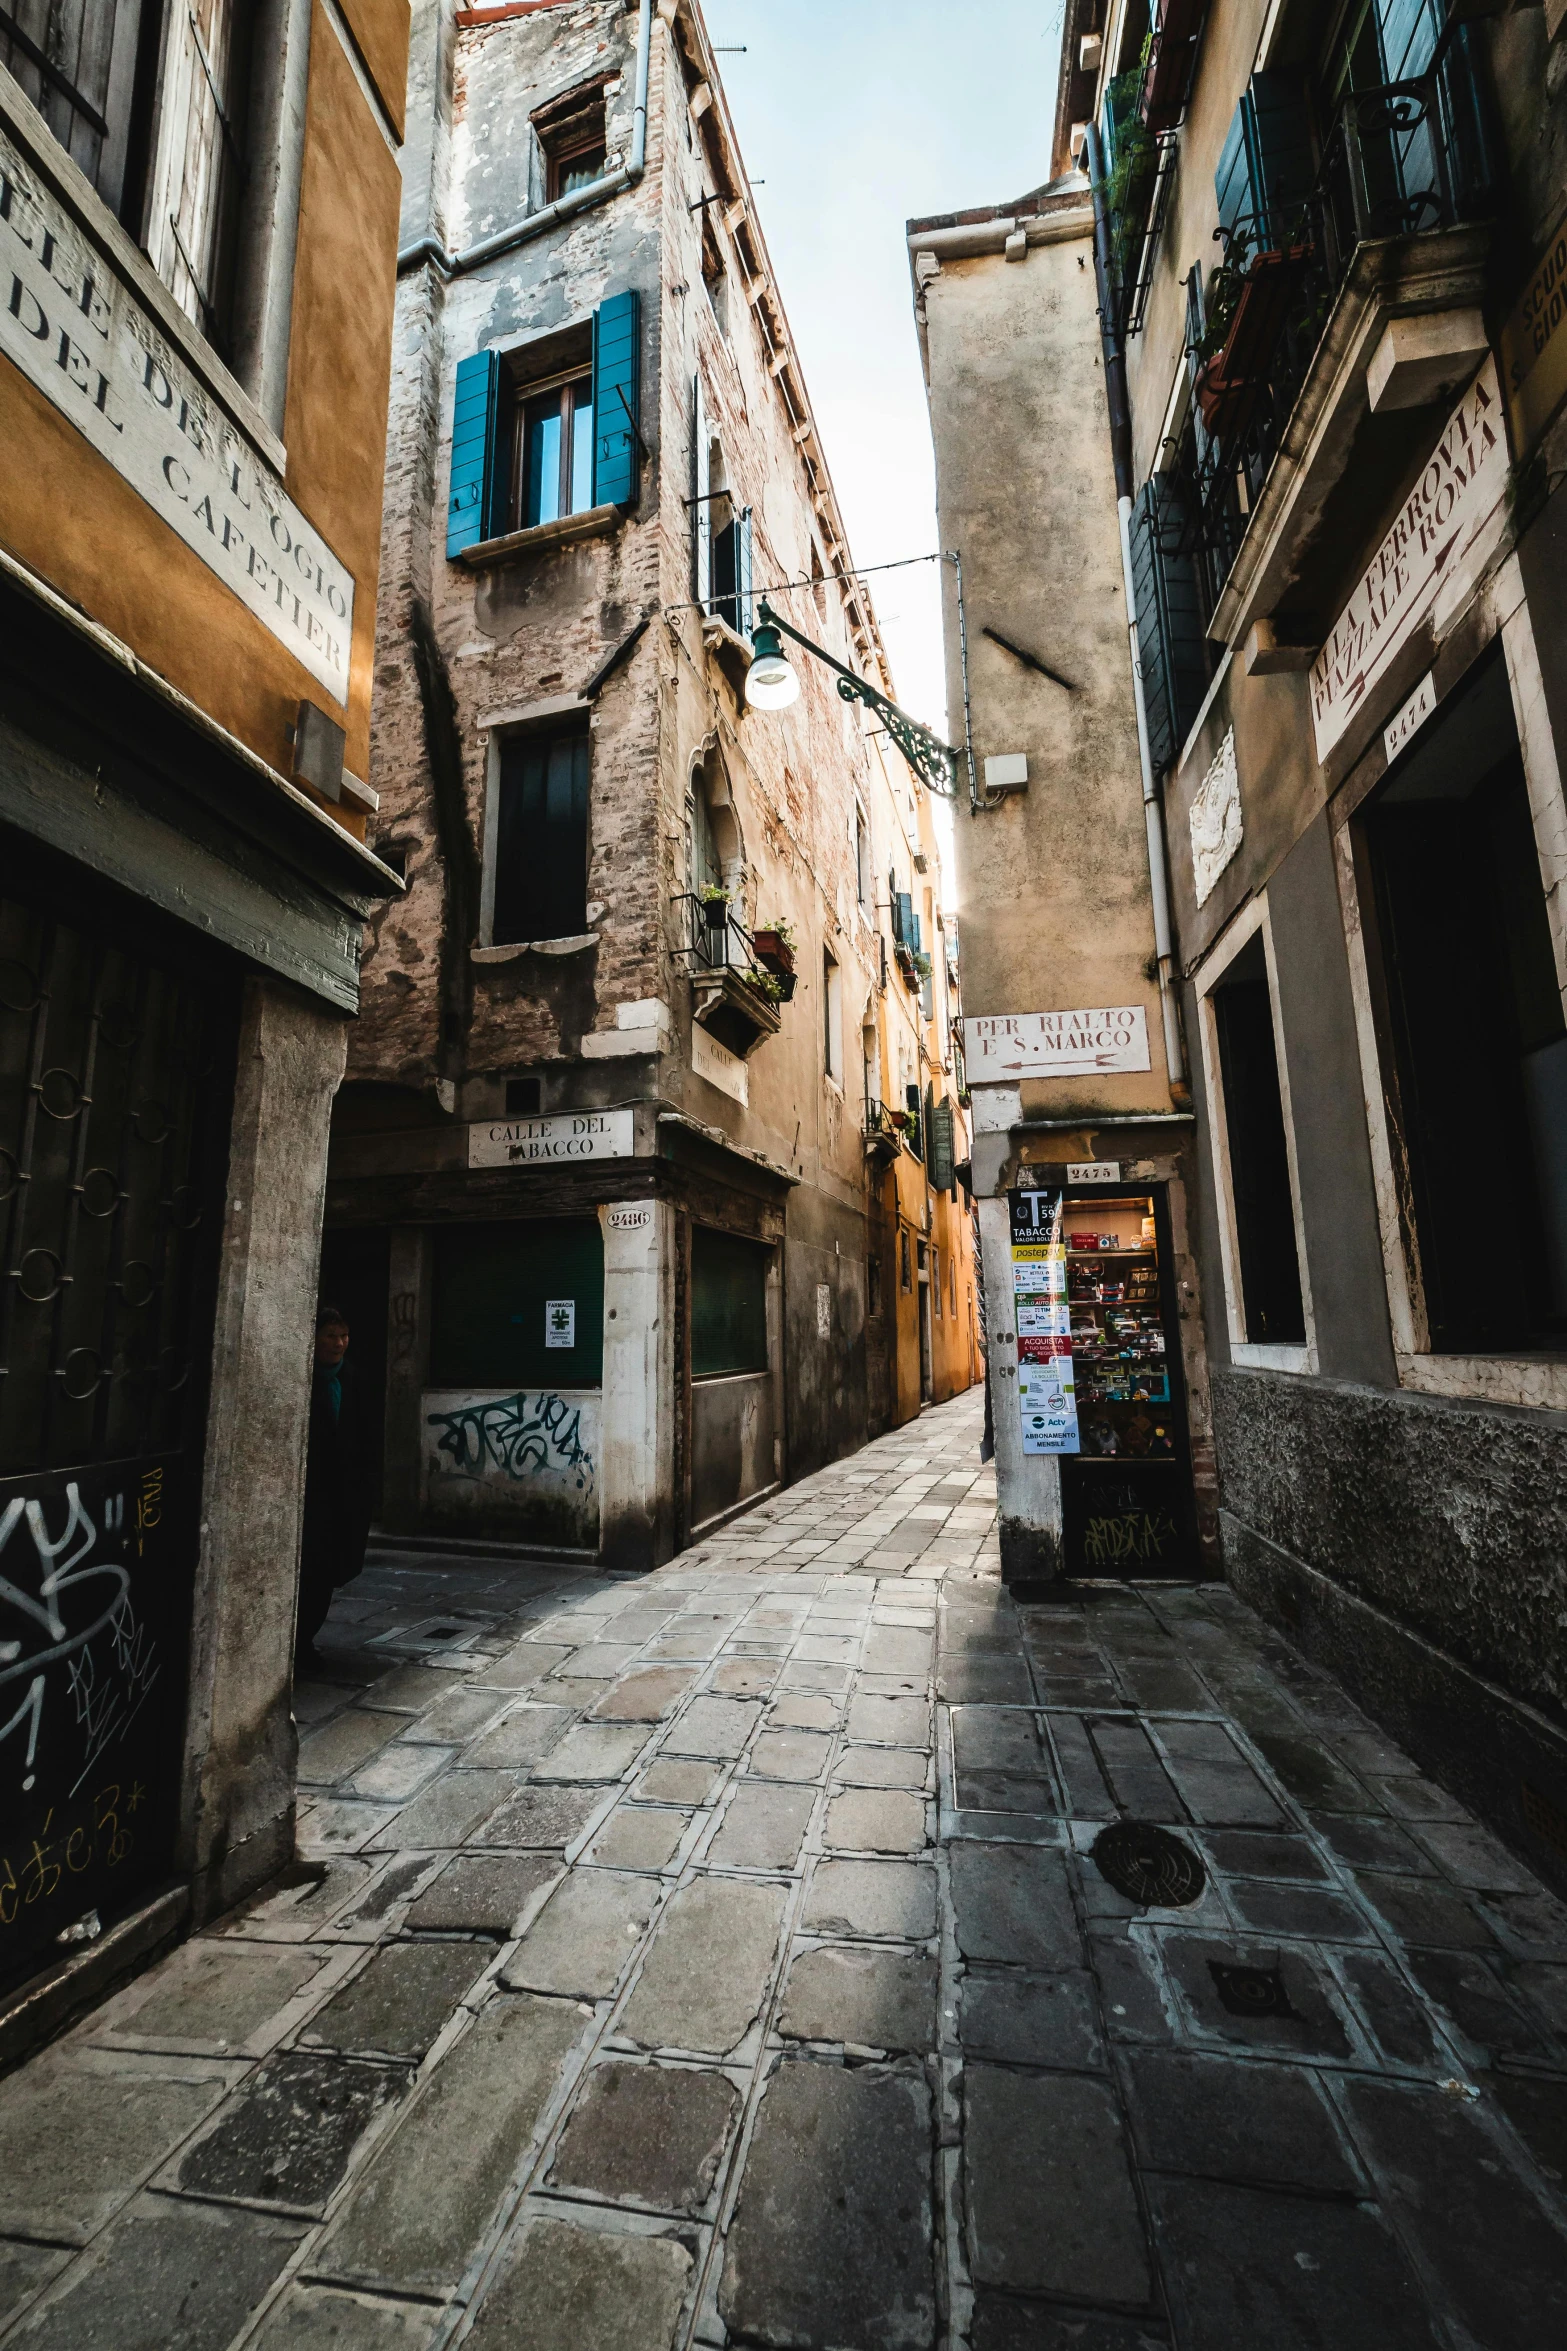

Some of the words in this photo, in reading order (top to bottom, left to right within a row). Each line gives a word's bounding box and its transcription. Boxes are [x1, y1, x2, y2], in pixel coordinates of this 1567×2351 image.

[7, 270, 124, 434] DEL
[162, 455, 342, 673] CAFETIER
[1313, 606, 1358, 686] ALLA
[1365, 381, 1494, 603] FERROVIA
[1315, 555, 1413, 722] PIAZZALE
[1420, 419, 1500, 557] ROMA
[1389, 692, 1428, 752] 2474
[976, 1018, 1020, 1038] PER
[1039, 1010, 1136, 1033] RIALTO
[982, 1038, 998, 1057] E
[489, 1121, 552, 1142] CALLE
[572, 1116, 612, 1136] DEL
[1070, 1167, 1112, 1180] 2475
[610, 1211, 648, 1228] 2486
[1020, 1191, 1048, 1227] T
[1013, 1227, 1060, 1237] TABACCO
